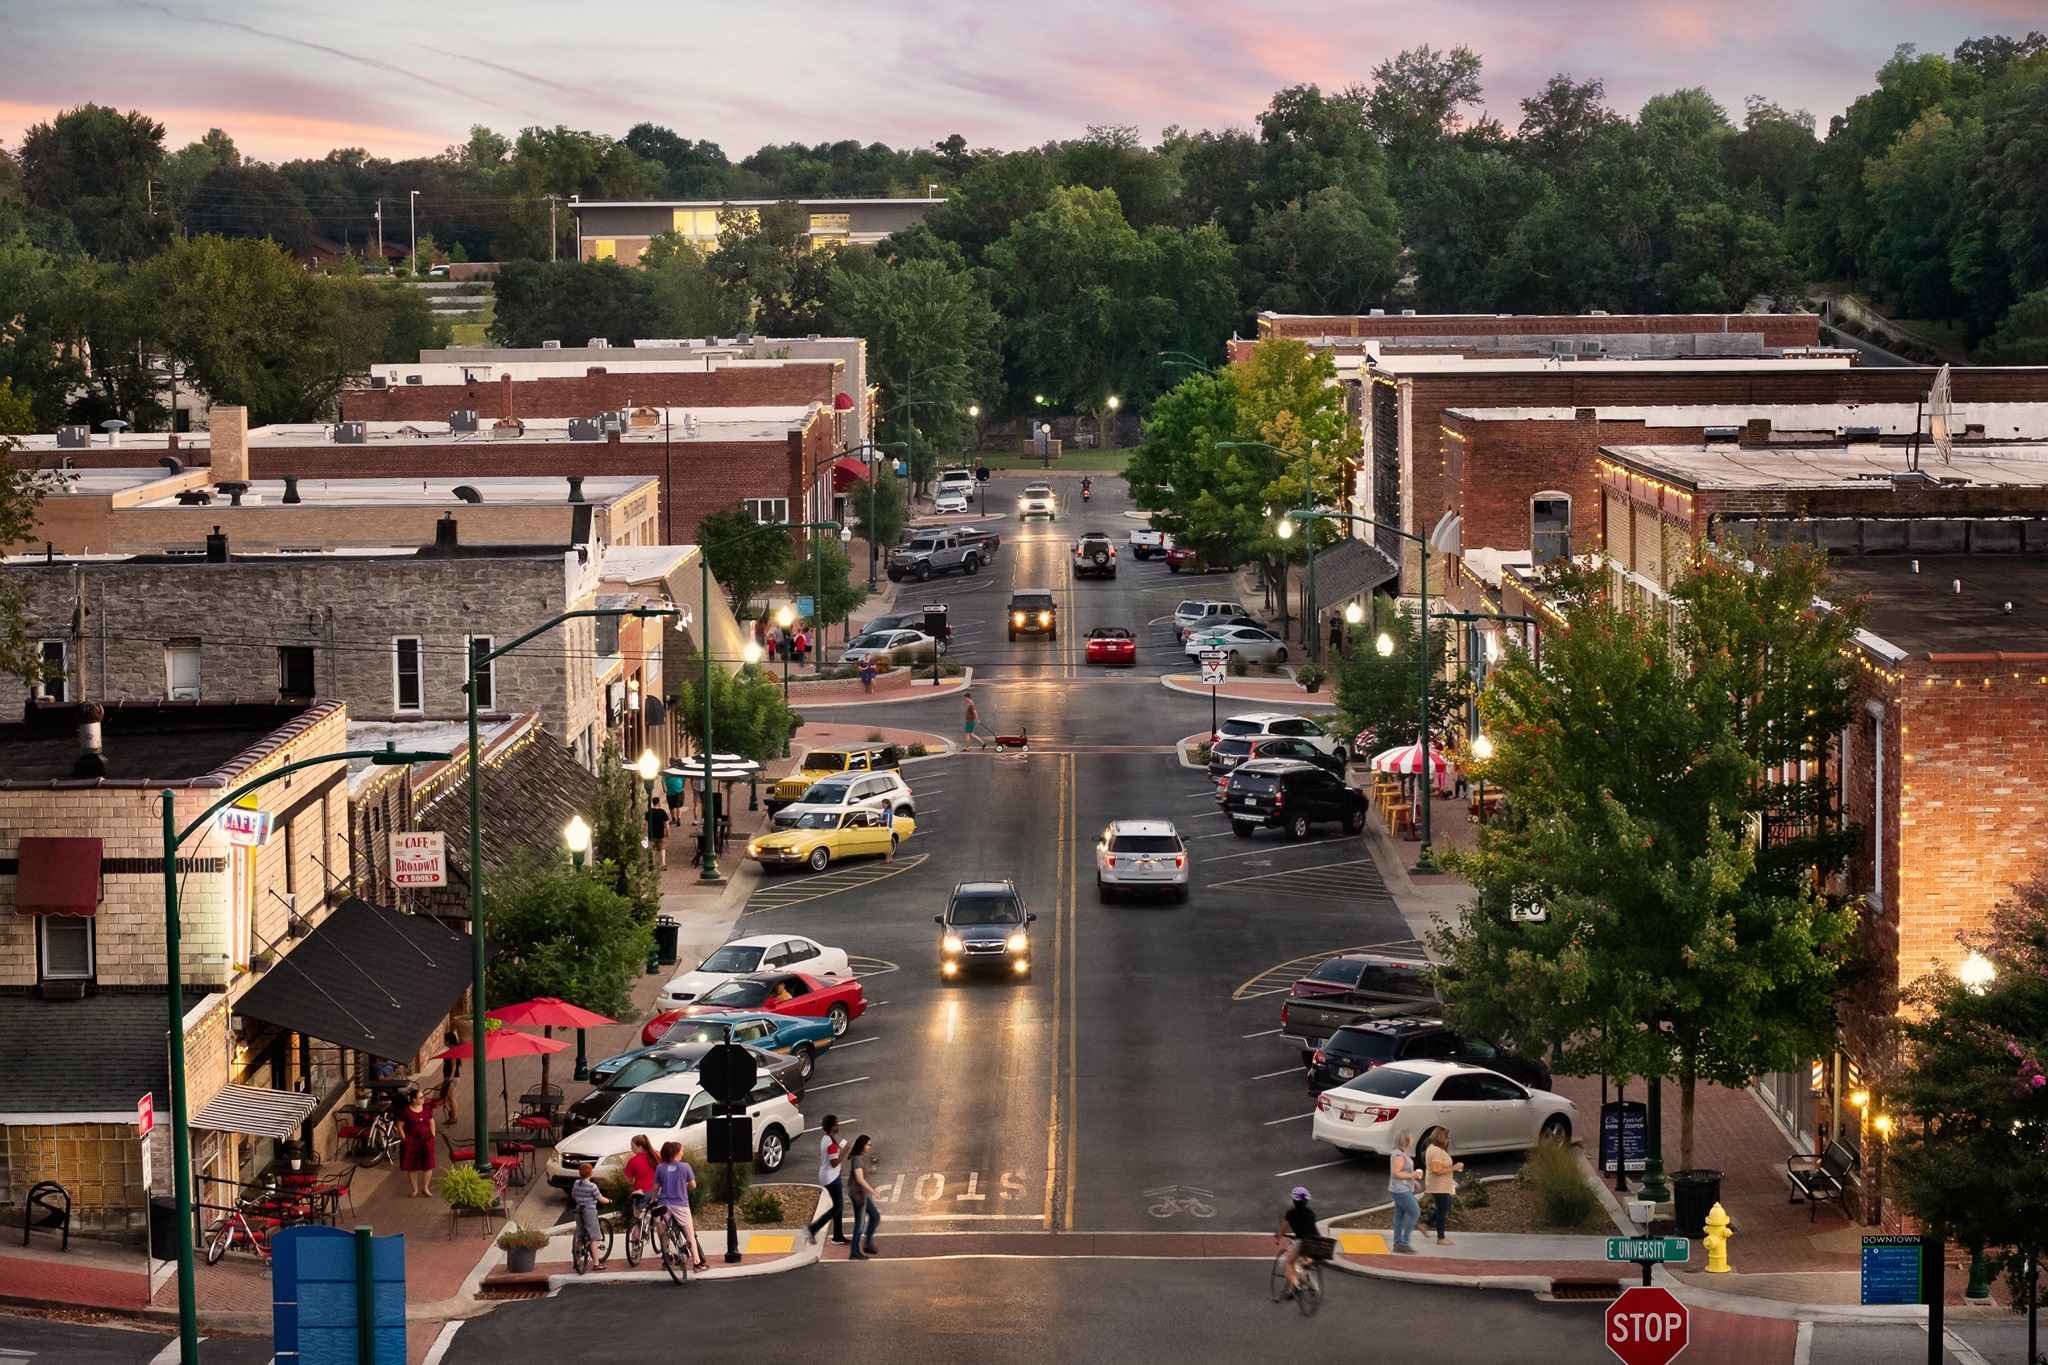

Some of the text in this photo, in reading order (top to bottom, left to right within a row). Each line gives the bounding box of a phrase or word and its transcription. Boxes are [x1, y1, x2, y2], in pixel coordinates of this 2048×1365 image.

[225, 813, 257, 834] CAFE
[405, 836, 428, 848] CAFE
[395, 856, 439, 872] BROADWAY
[874, 1172, 1026, 1202] STOP
[1863, 1236, 1920, 1244] DOWNTOWN
[1609, 1241, 1615, 1259] E
[1618, 1241, 1666, 1259] UNIVERSITY
[1612, 1312, 1682, 1343] STOP
